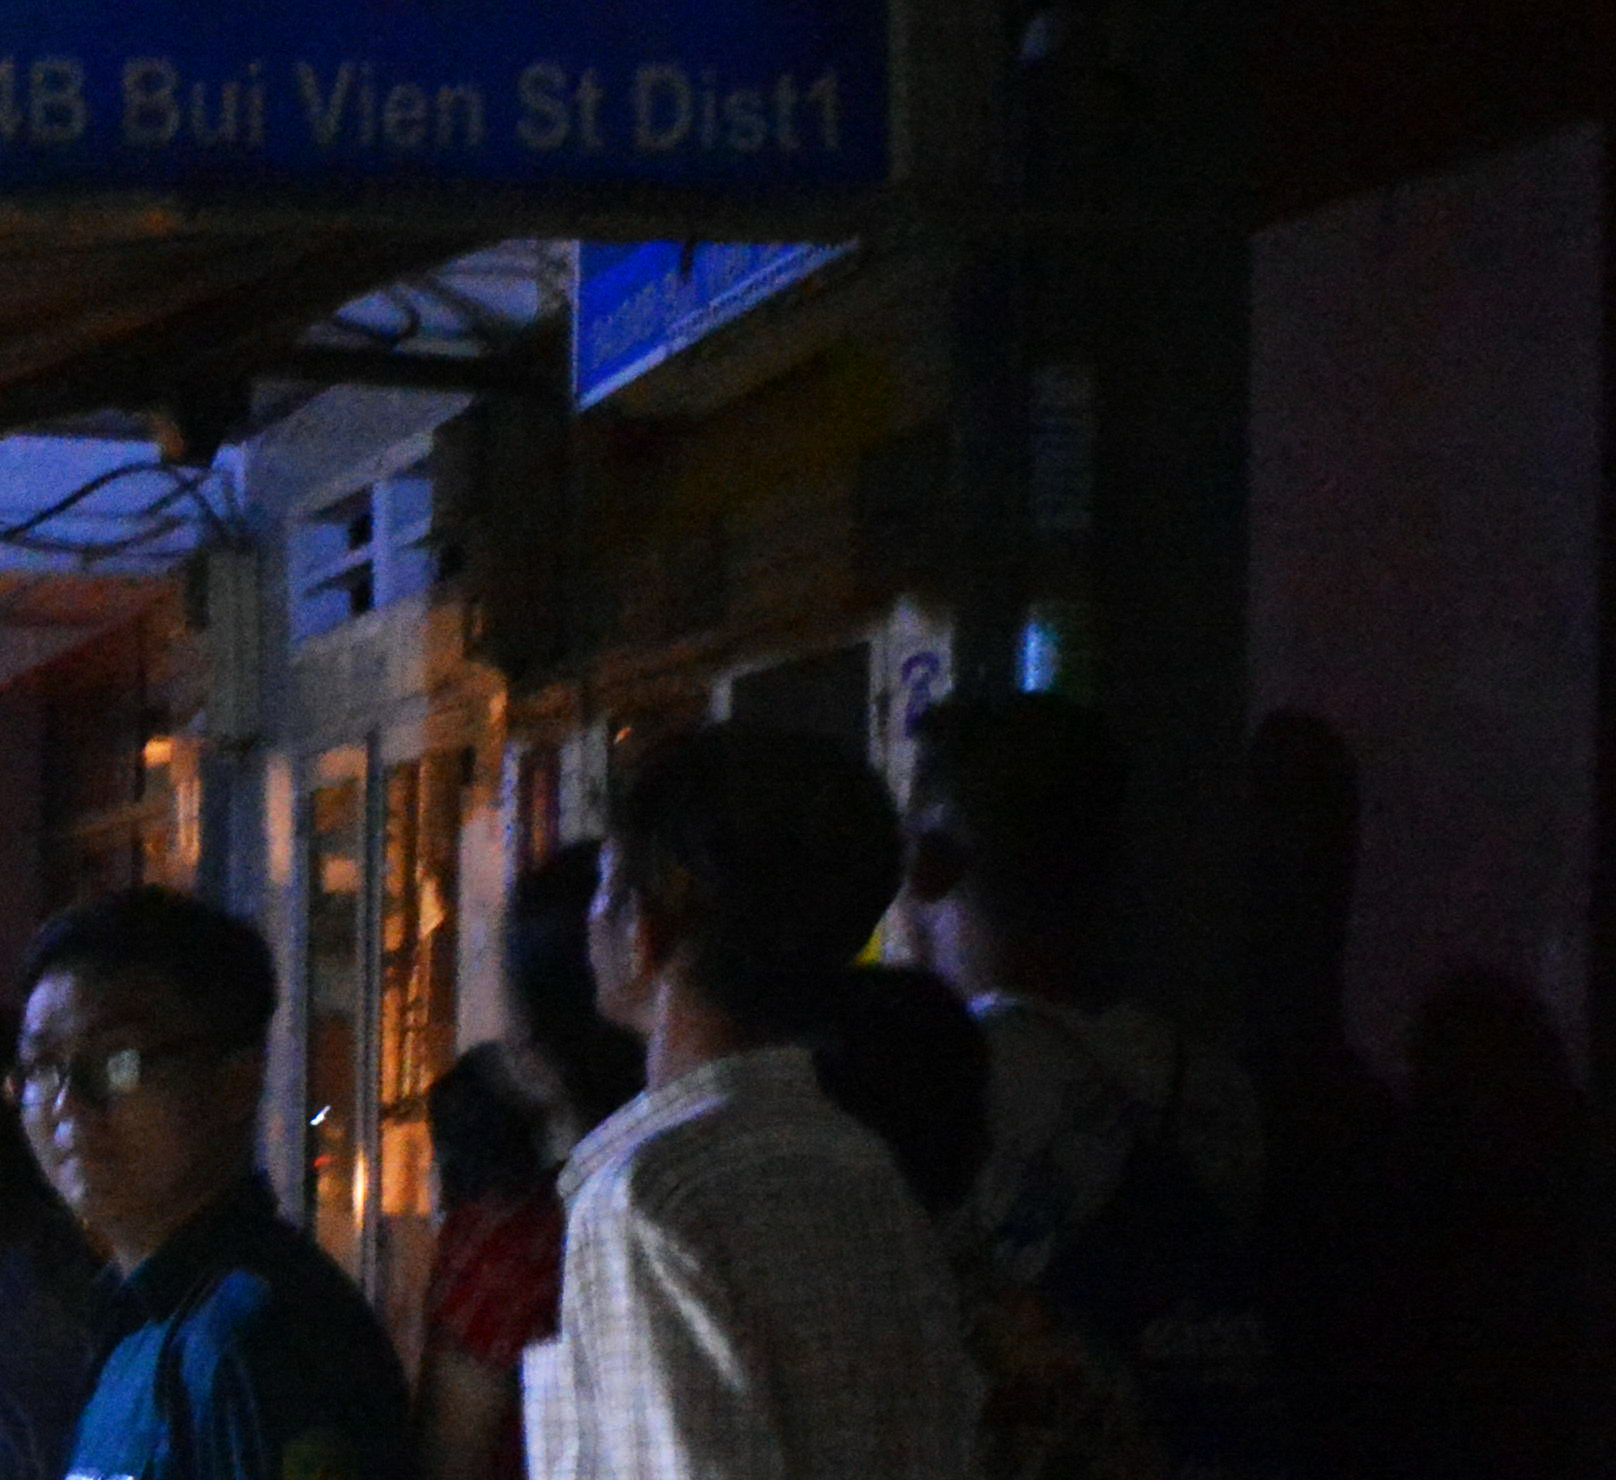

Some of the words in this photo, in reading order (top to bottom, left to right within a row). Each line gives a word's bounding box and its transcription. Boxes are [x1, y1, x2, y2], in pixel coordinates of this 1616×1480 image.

[121, 56, 267, 148] Bui
[296, 60, 486, 150] Vien
[514, 61, 604, 152] St
[631, 62, 844, 152] Dist1
